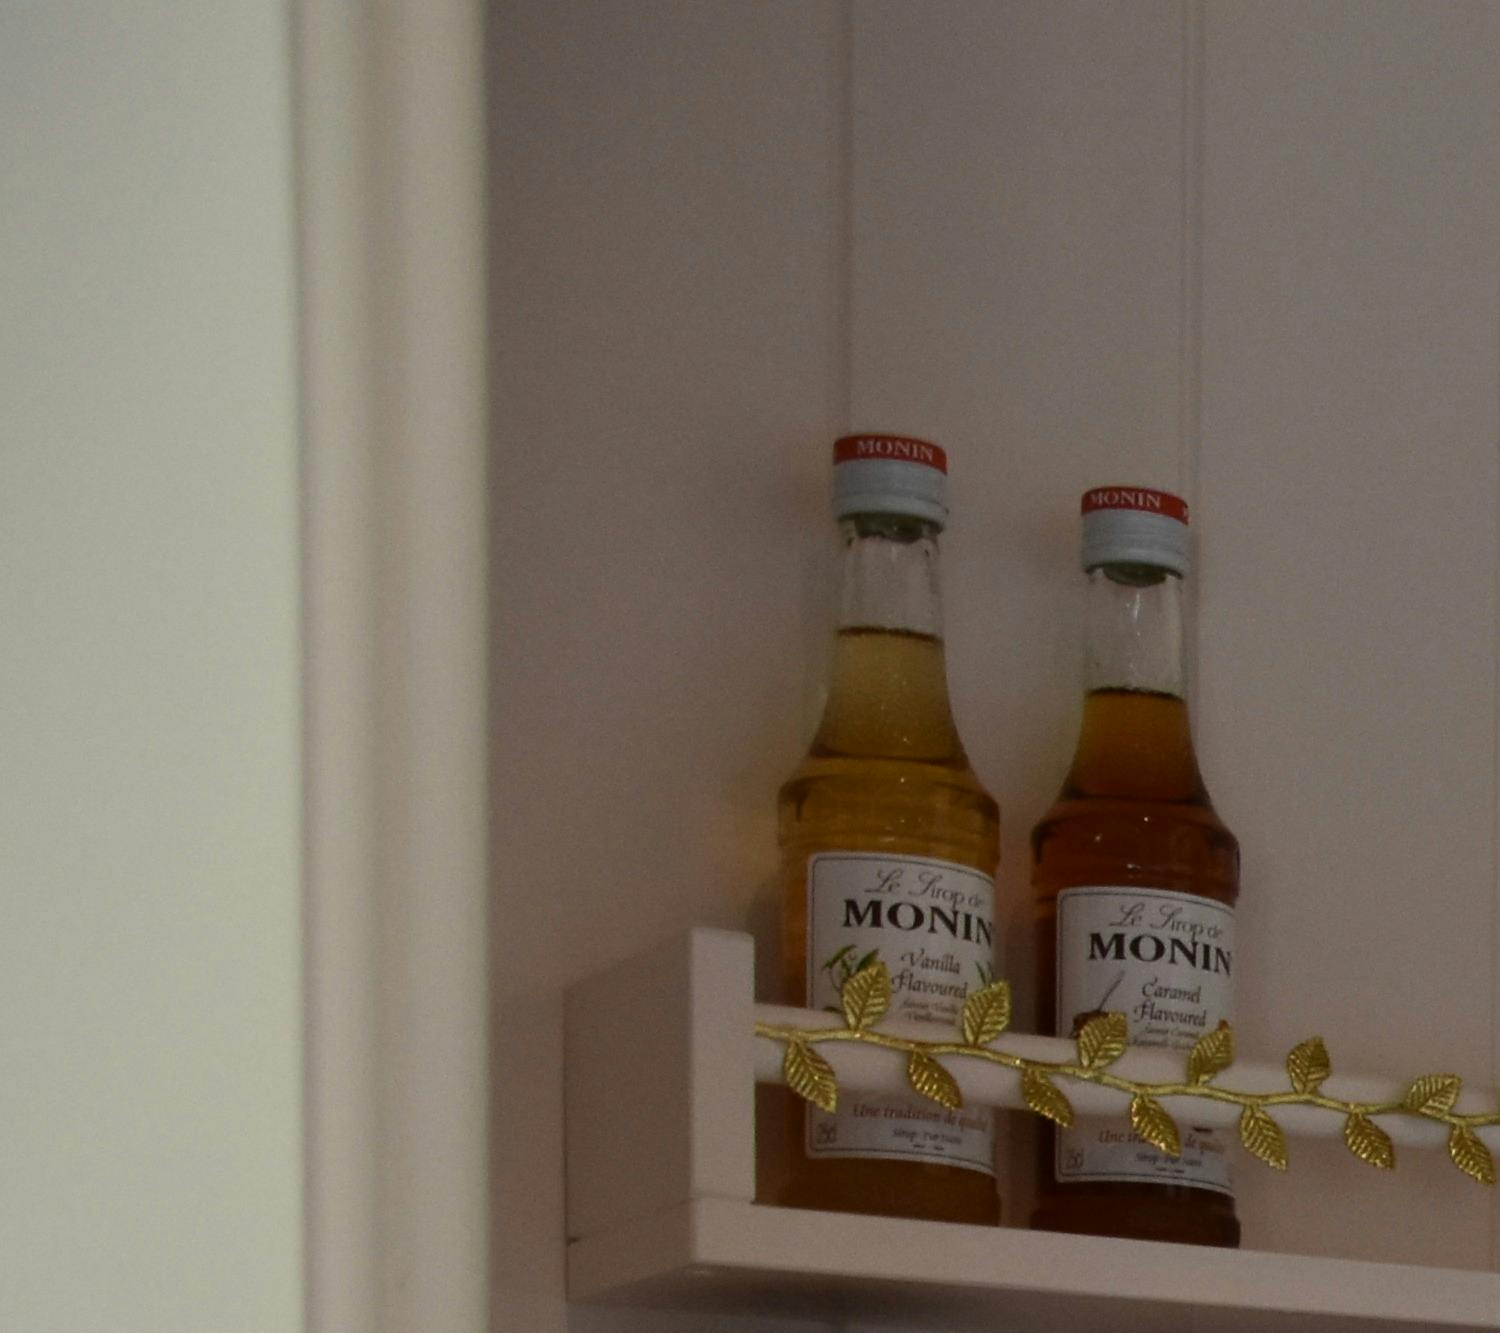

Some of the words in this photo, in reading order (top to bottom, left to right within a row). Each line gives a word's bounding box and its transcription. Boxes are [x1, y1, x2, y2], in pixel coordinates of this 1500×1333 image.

[856, 438, 934, 462] MONIN
[1090, 488, 1161, 509] MONIN
[864, 867, 904, 894] Le
[842, 897, 992, 947] MONIN
[1109, 902, 1145, 927] Le
[900, 948, 961, 975] Vanilla
[1088, 932, 1232, 978] MONIN
[890, 968, 968, 1000] Flavoured
[1141, 976, 1203, 1004] Caramel
[1134, 1001, 1207, 1028] Flavoured
